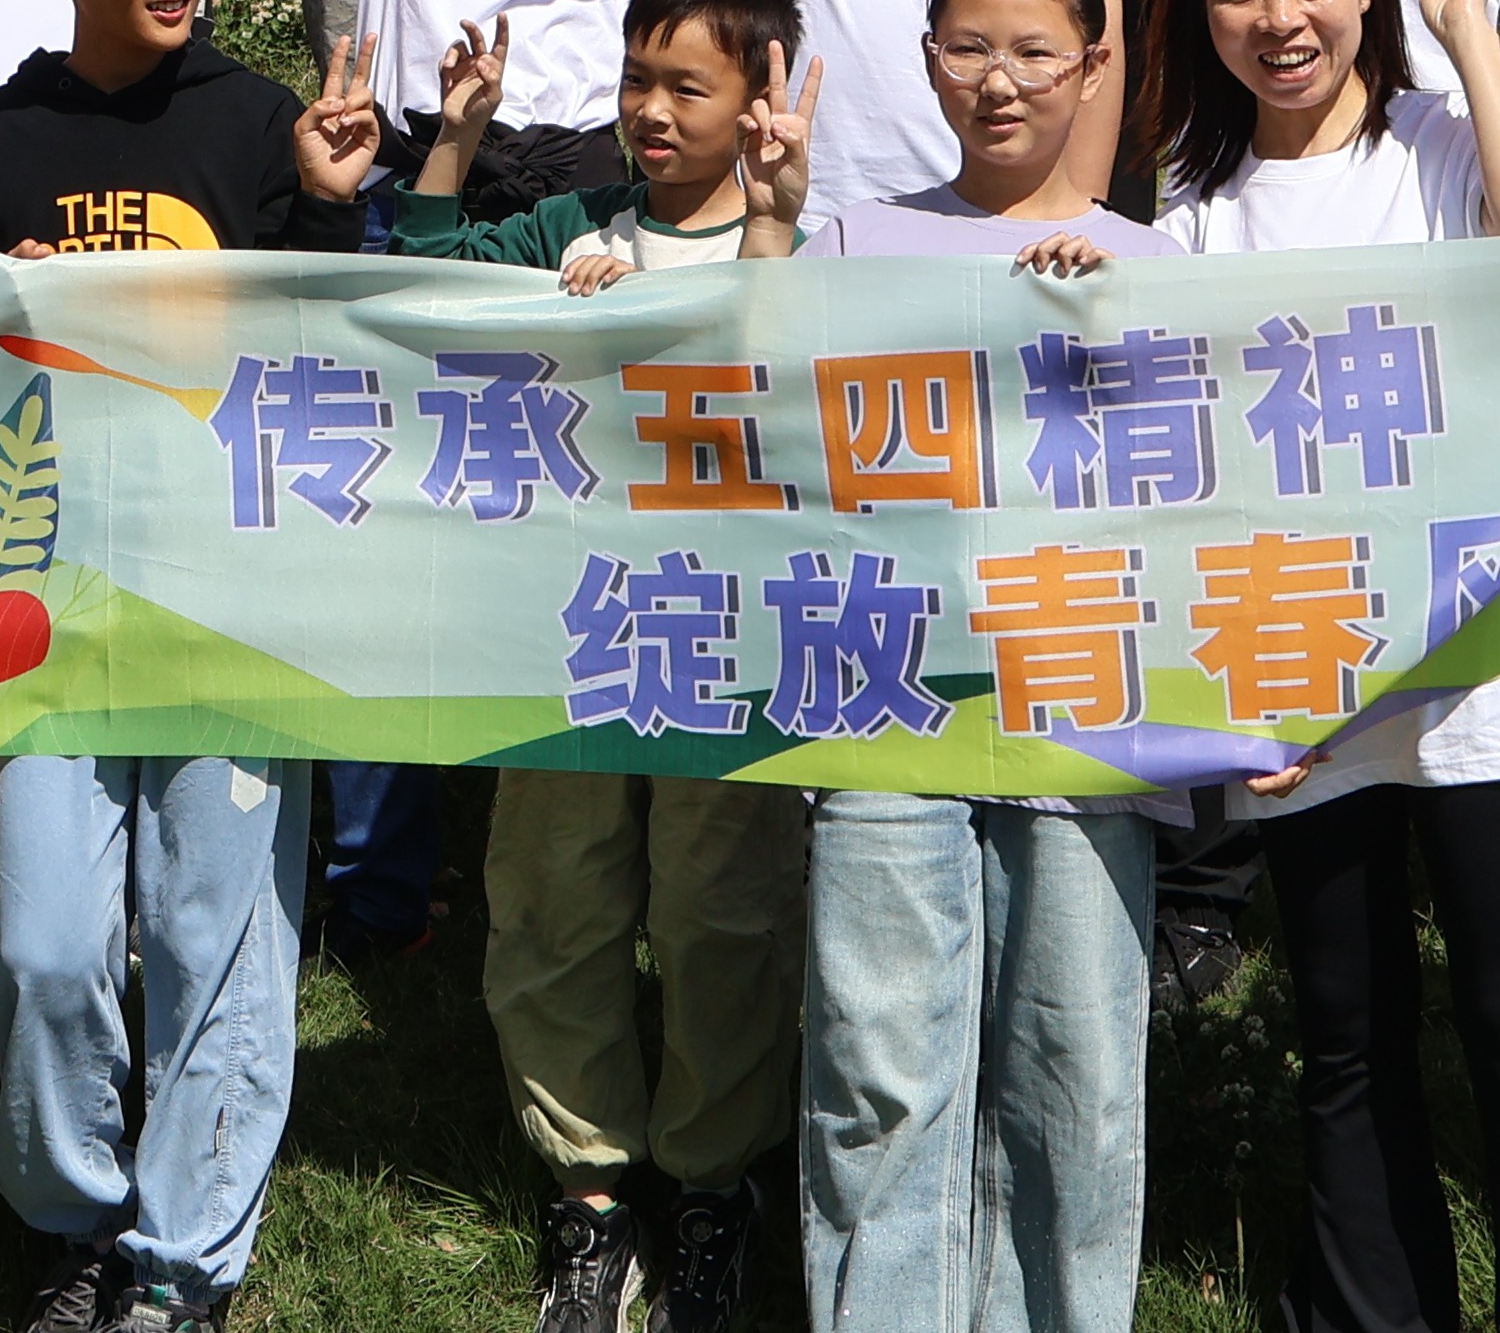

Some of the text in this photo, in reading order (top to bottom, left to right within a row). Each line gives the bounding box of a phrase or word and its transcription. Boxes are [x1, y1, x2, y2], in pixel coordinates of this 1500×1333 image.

[56, 190, 142, 235] THE
[208, 301, 1447, 530] 传承五四精神
